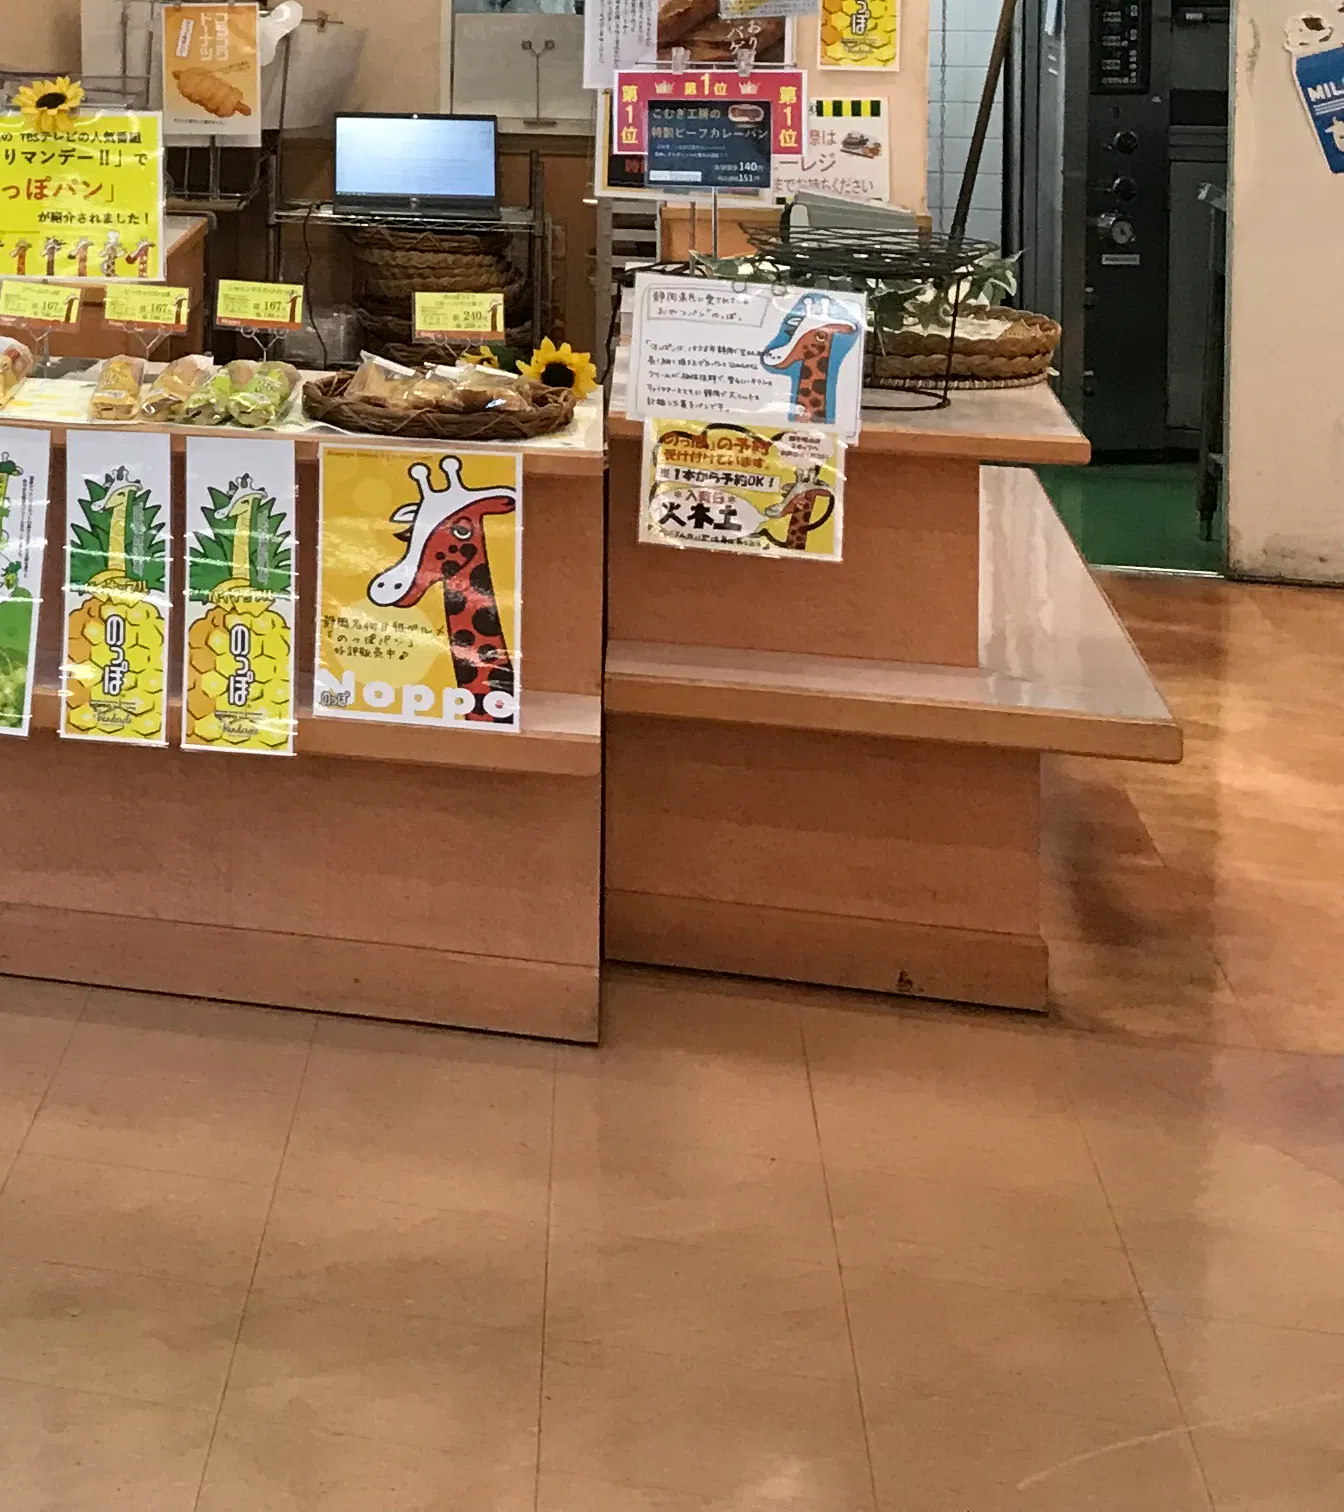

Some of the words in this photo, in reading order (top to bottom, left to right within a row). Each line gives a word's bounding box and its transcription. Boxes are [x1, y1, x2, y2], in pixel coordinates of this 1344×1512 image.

[621, 85, 639, 144] 第1位
[779, 86, 798, 148] 第1位
[1308, 82, 1344, 102] MIL
[774, 153, 836, 173] ーレジ
[38, 212, 149, 225] が紹介されました！
[659, 501, 743, 532] 火木土
[102, 615, 129, 696] のっぽ
[228, 624, 256, 706] のっぽ
[317, 669, 514, 720] Noppo
